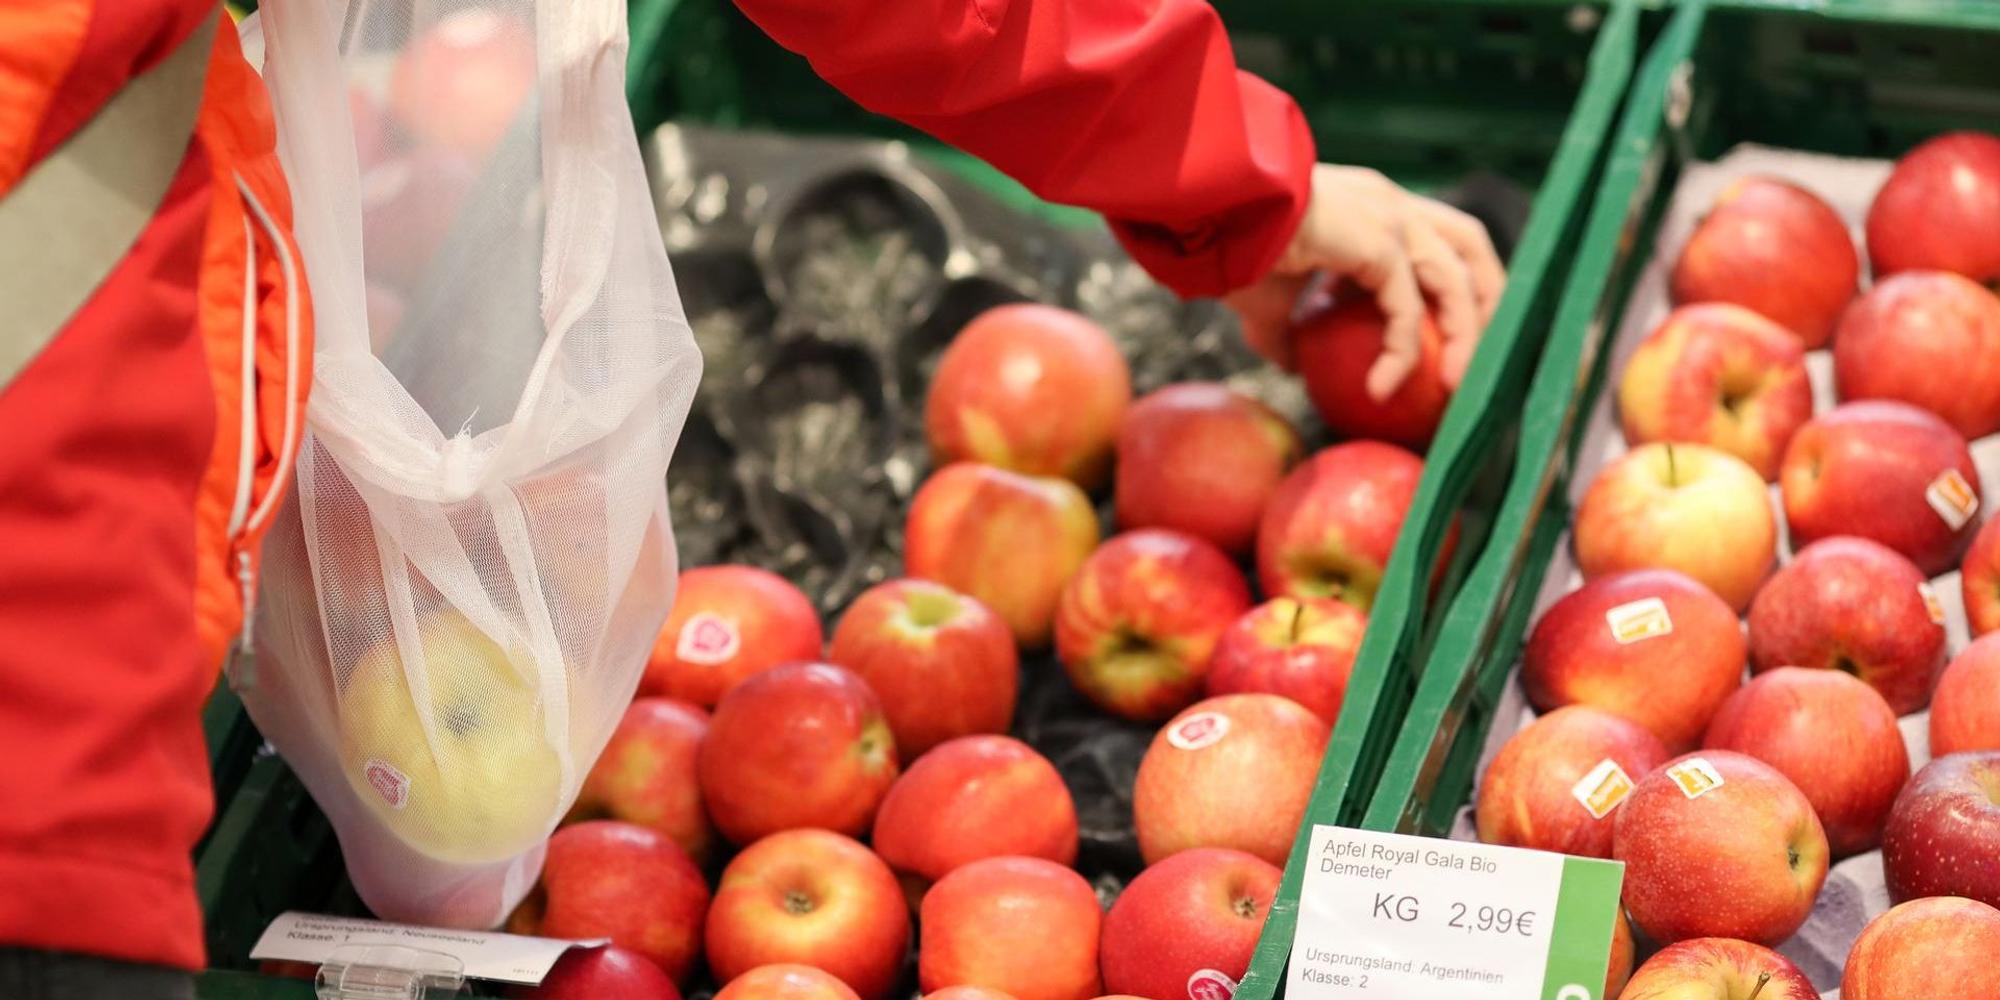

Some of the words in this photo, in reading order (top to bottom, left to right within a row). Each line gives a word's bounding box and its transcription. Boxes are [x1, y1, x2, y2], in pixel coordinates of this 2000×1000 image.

[1320, 857, 1393, 880] Demeter
[1322, 839, 1366, 859] Apfel
[1371, 843, 1420, 866] Royal
[1424, 850, 1465, 870] Gala
[1470, 856, 1497, 874] Bio
[1372, 892, 1420, 922] KG
[1448, 902, 1537, 937] 2,99€
[1301, 967, 1353, 988] Klasse:
[1358, 974, 1369, 989] 2
[1305, 947, 1415, 974] Ursprungsland:
[1419, 961, 1505, 984] Argentinien
